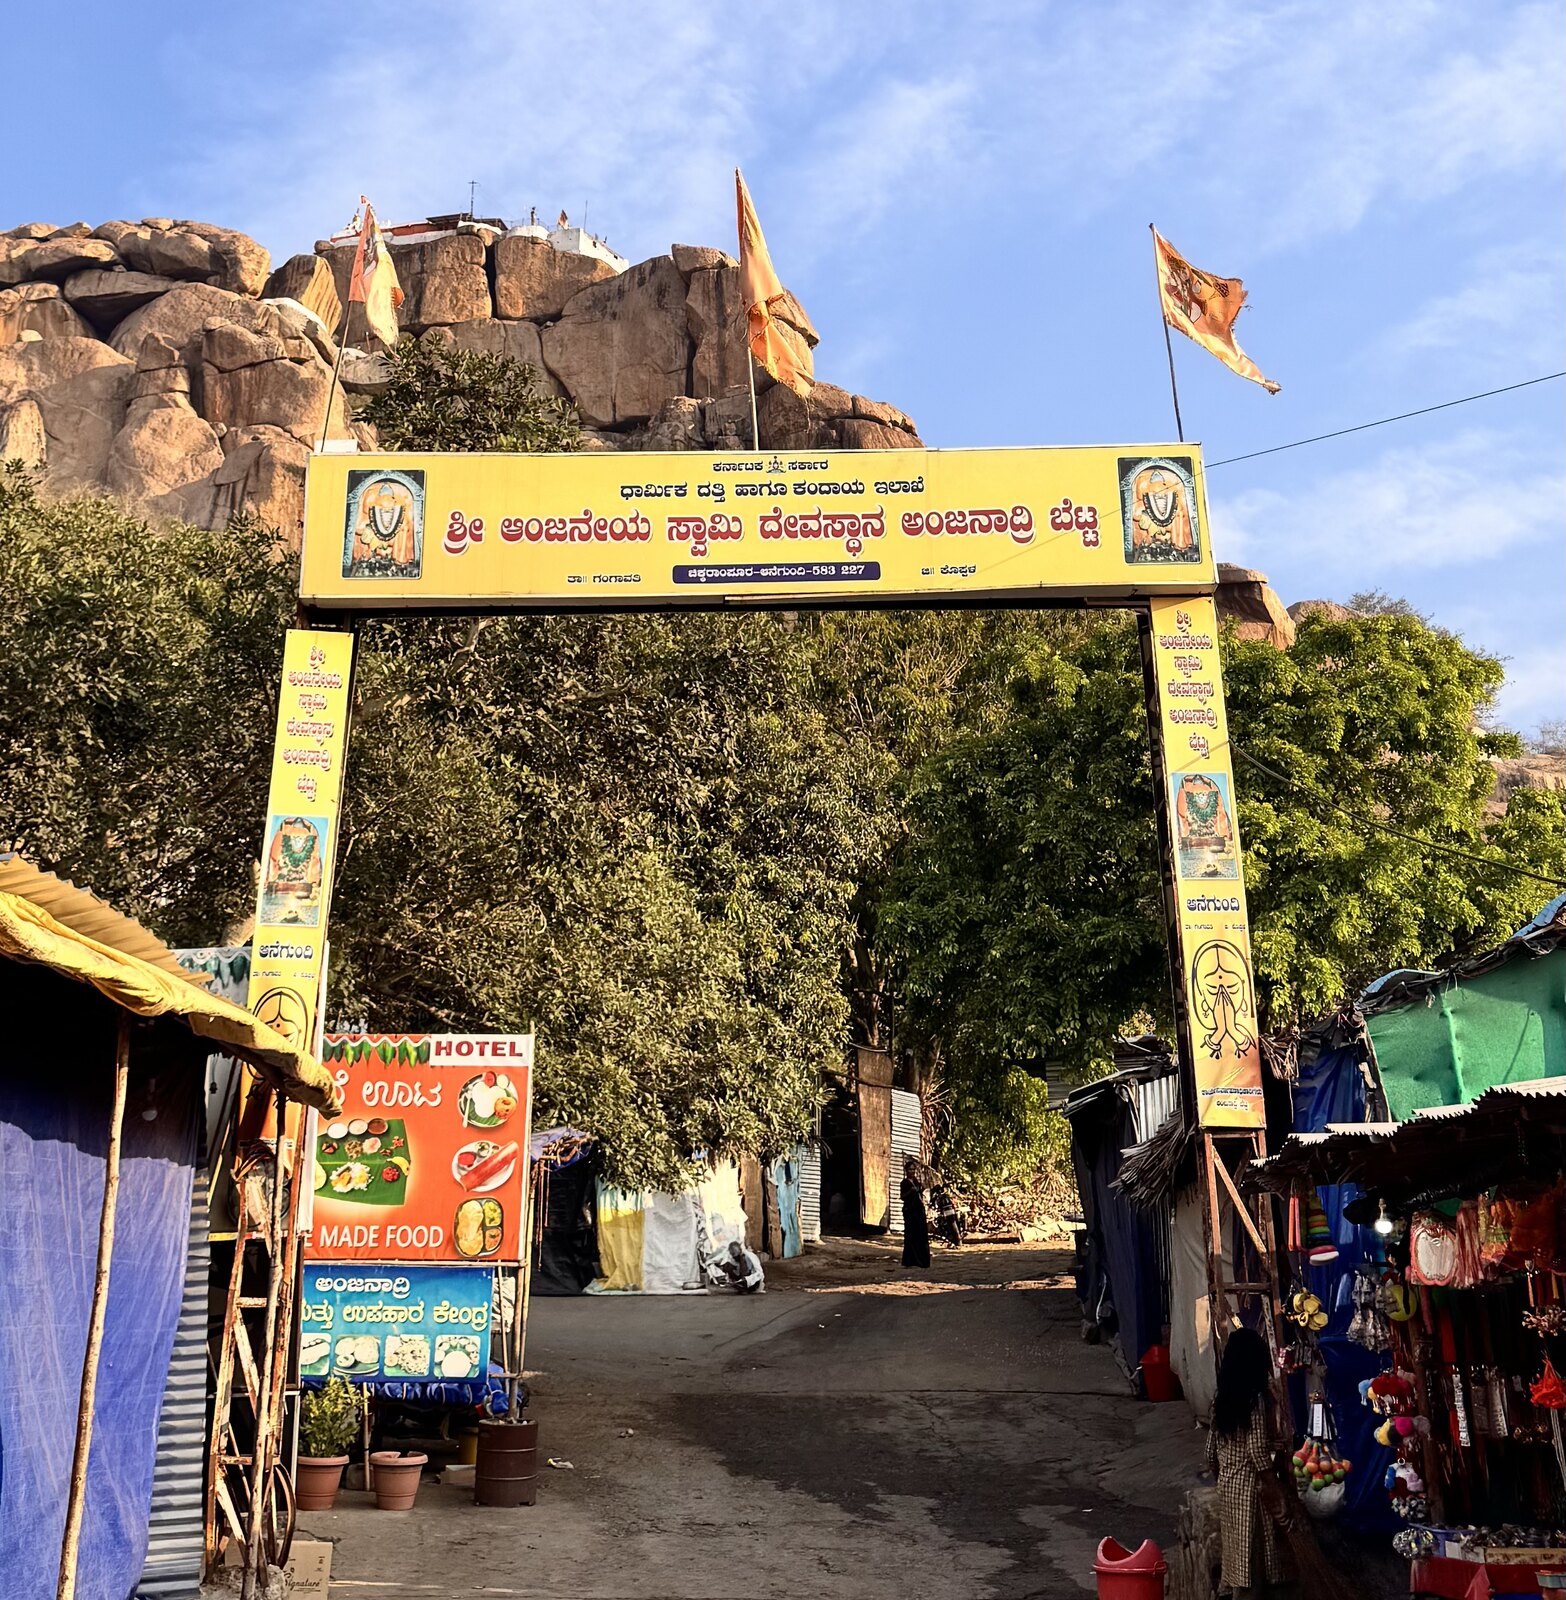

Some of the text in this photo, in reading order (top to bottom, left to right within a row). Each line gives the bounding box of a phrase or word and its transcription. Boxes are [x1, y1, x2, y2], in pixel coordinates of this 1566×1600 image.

[712, 459, 829, 472] ಕರ್ನಾಟಕ ಸರ್ಕಾರ
[620, 475, 925, 503] ಧಾರ್ಮಿಕ ದತ್ತಿ ಹಾಗೂ ಕಂದಾಯ ಇಲಾಖೆ
[443, 498, 1100, 557] ಶ್ರೀ ಆಂಜನೇಯ ಸ್ವಾಮಿ ದೇವಸ್ಥಾನ ಅಂಜನಾದ್ರಿ ಬೆಟ್ಟ
[592, 573, 641, 584] ಗಂಗಾವತಿ
[841, 564, 865, 576] 227
[940, 564, 977, 577] ಕೊಪ್ಪಳ
[1173, 654, 1203, 678] ಸ್ವಾಮಿ
[434, 1040, 523, 1058] HOTEL
[362, 1080, 443, 1107] ಊಟ
[319, 1225, 380, 1248] MADE
[385, 1225, 444, 1248] FOOD
[315, 1276, 411, 1299] ಅಂಜನಾದ್ರಿ
[342, 1299, 425, 1324] ಉಪಹಾರ
[433, 1299, 489, 1332] ಕೇಂದ್ರ
